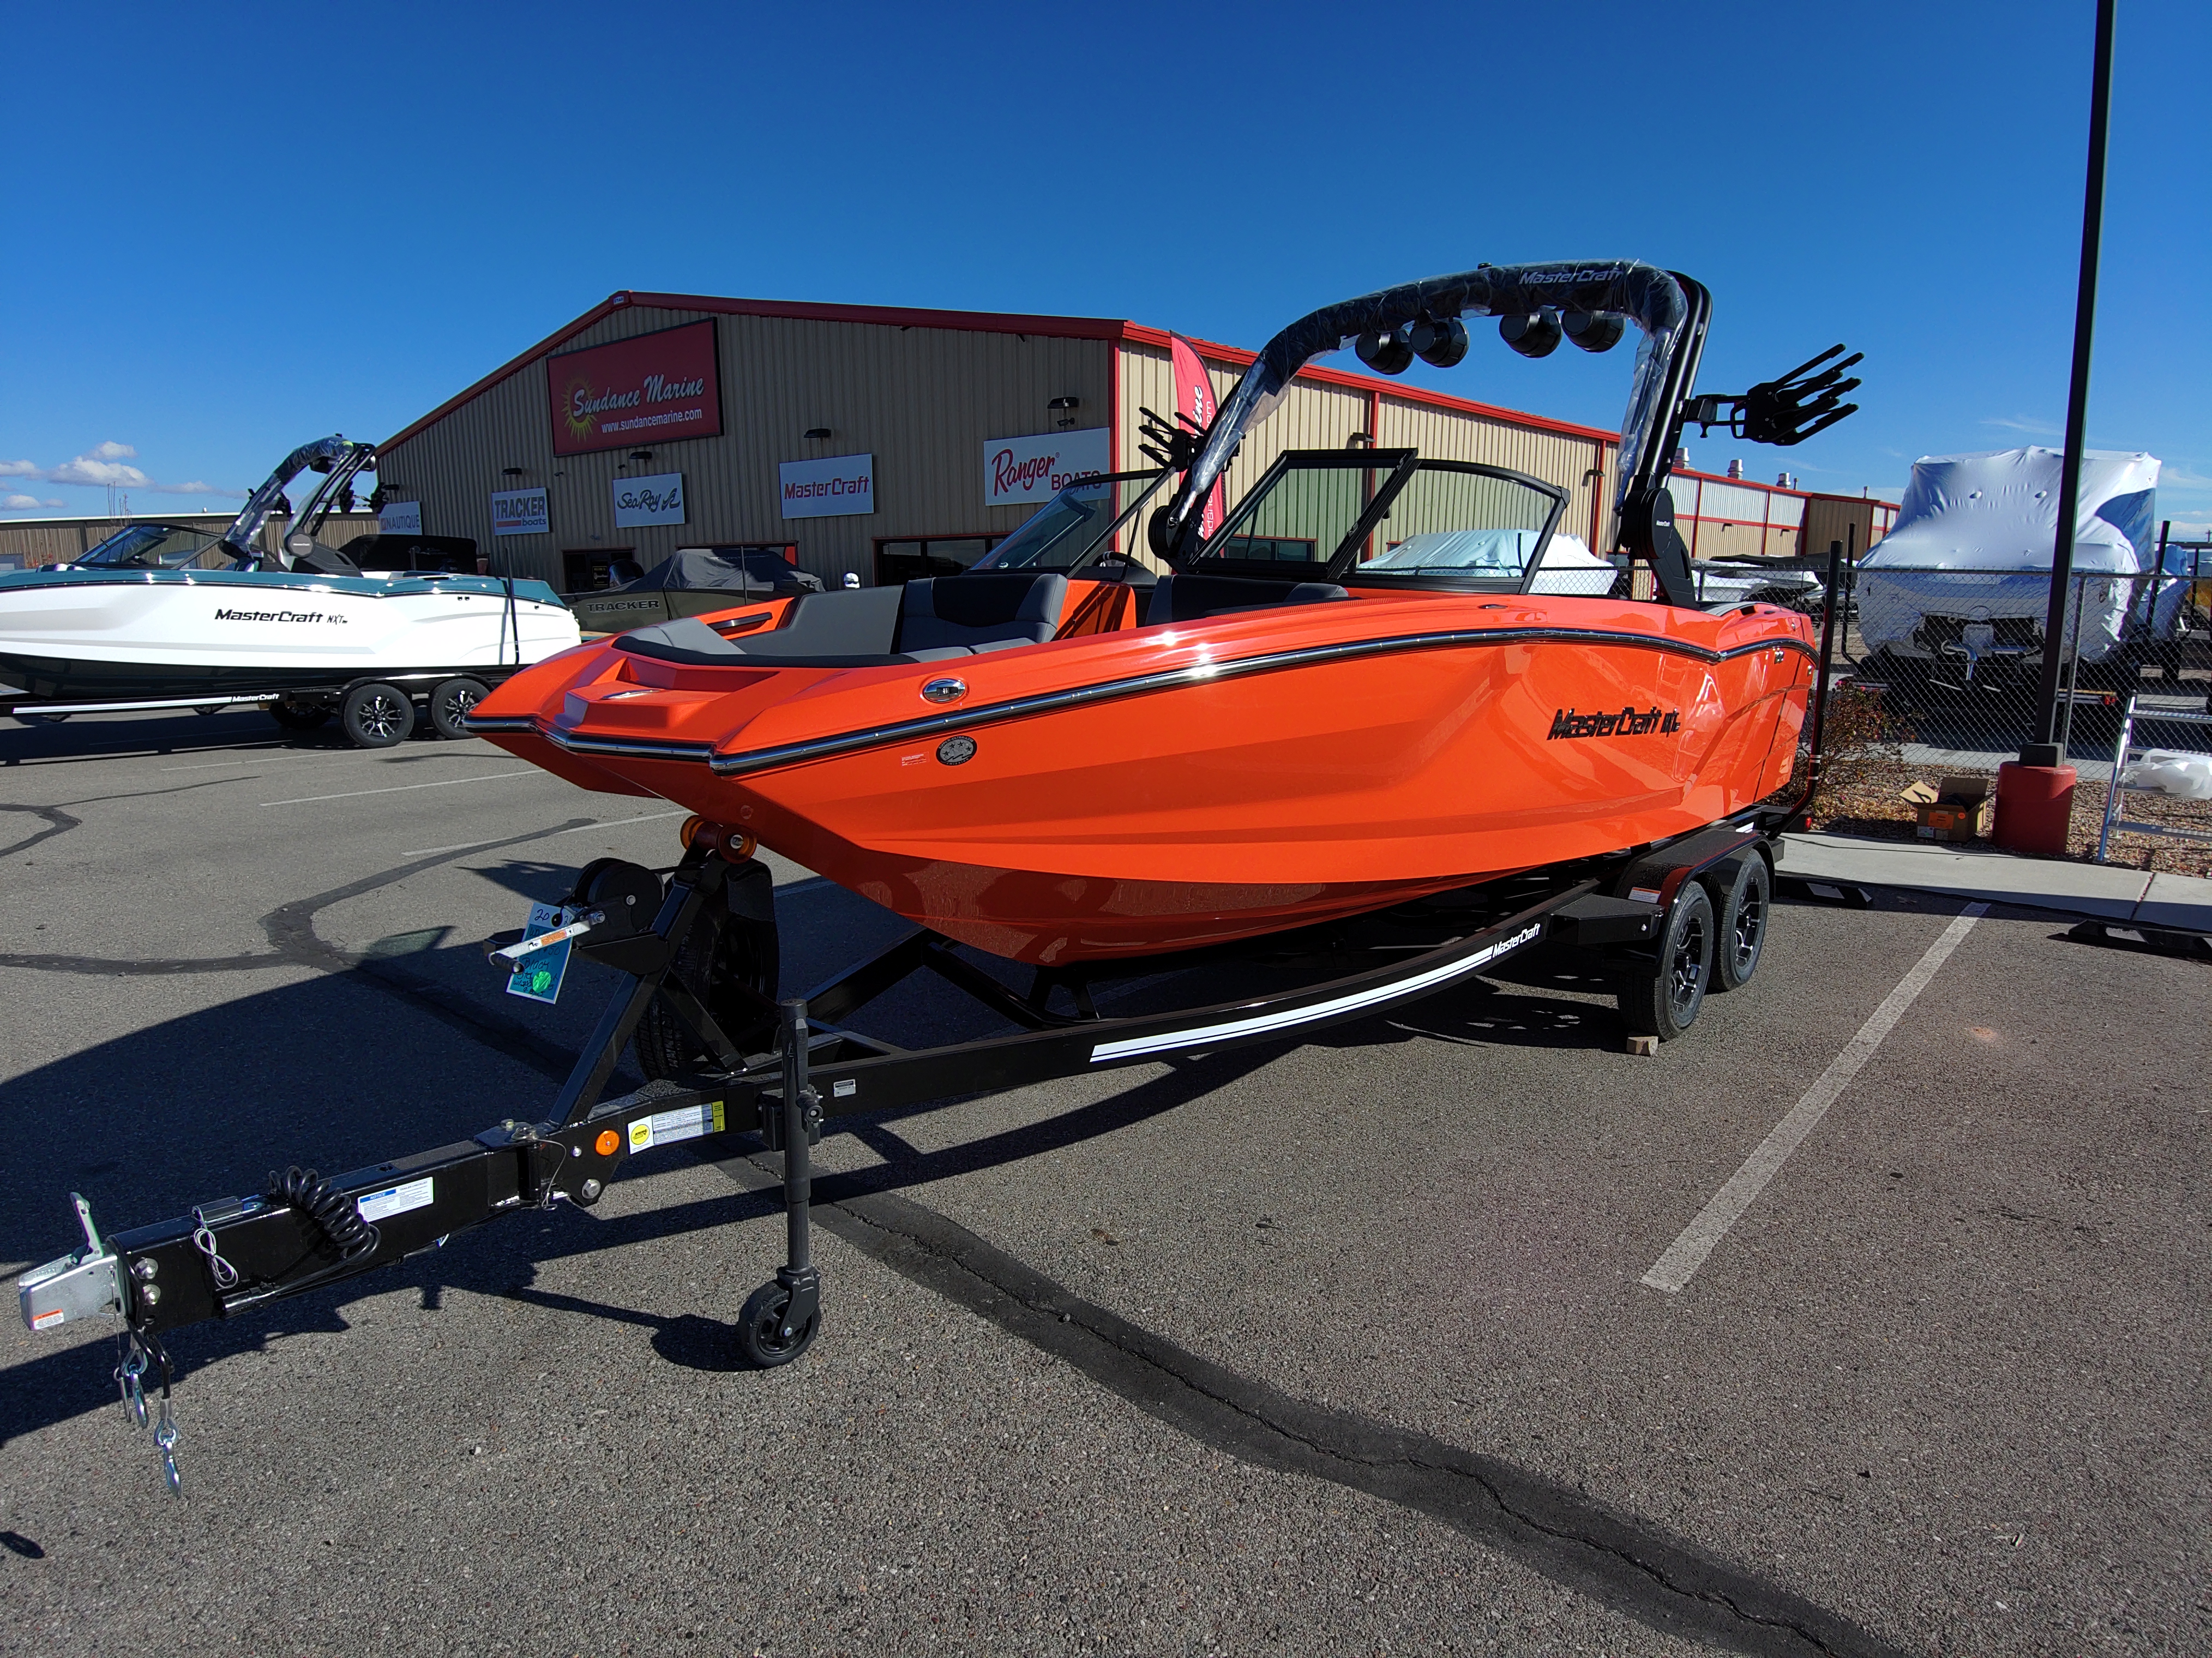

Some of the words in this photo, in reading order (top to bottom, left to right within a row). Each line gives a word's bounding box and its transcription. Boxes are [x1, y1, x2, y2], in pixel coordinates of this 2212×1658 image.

[573, 386, 640, 417] Sundance
[644, 373, 704, 403] Marine
[602, 408, 702, 434] www.sundancemarine.com
[991, 448, 1056, 497] Ranger
[784, 476, 869, 500] MasterCraft
[495, 495, 545, 519] TRACKER
[386, 514, 420, 529] NAUTIQUE
[522, 518, 546, 526] boats
[214, 609, 323, 623] MasterCraft
[586, 600, 659, 612] TRACKER
[232, 693, 280, 702] MasterCraft
[1547, 706, 1662, 741] MasterCraft
[1492, 923, 1541, 958] MasterCraft
